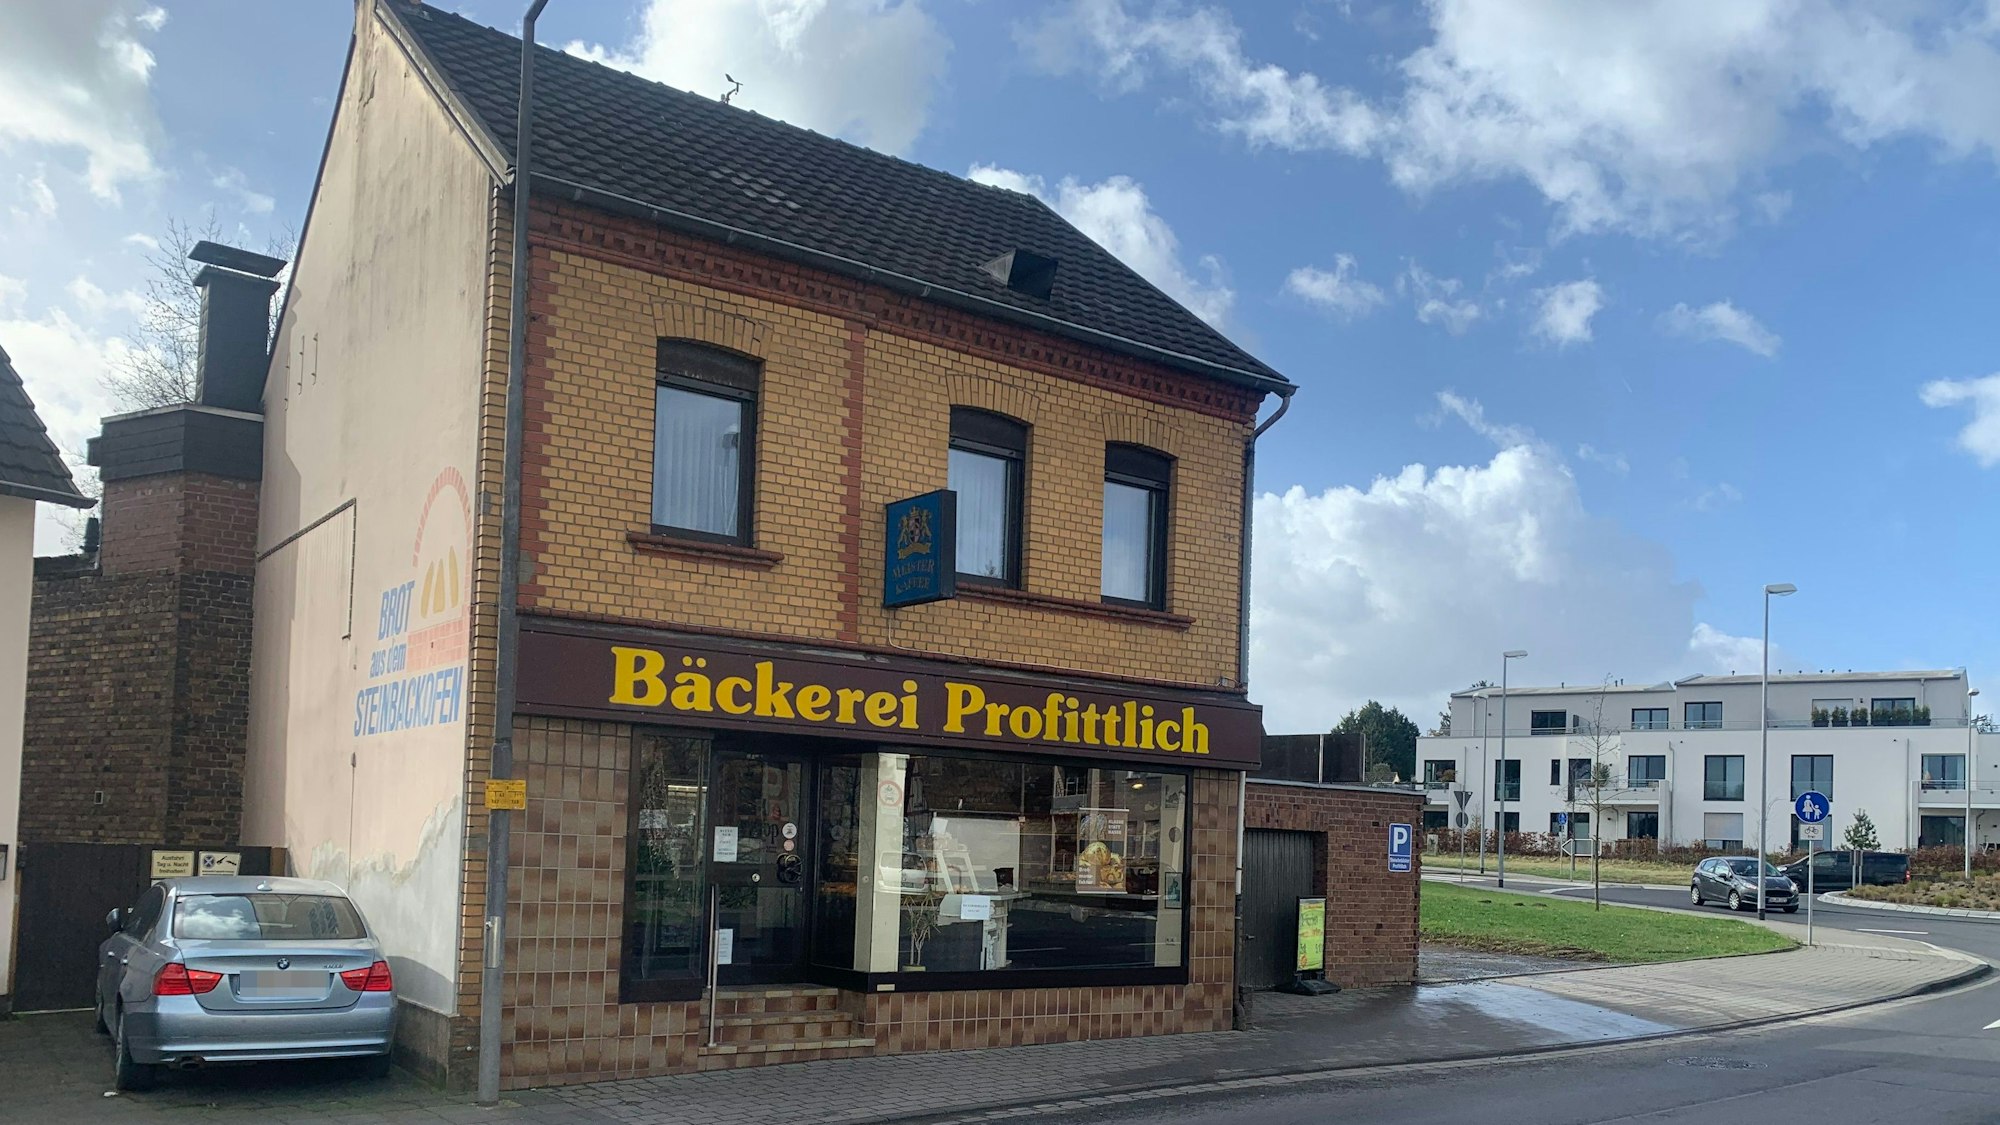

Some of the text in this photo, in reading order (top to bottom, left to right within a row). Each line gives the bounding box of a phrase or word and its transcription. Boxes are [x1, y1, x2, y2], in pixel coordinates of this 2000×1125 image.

[378, 580, 415, 641] BROT
[370, 640, 408, 679] aus dem
[354, 666, 464, 737] STEINBACKOFEN
[608, 646, 1211, 755] Bäckerei Profittlich
[1393, 826, 1408, 853] P
